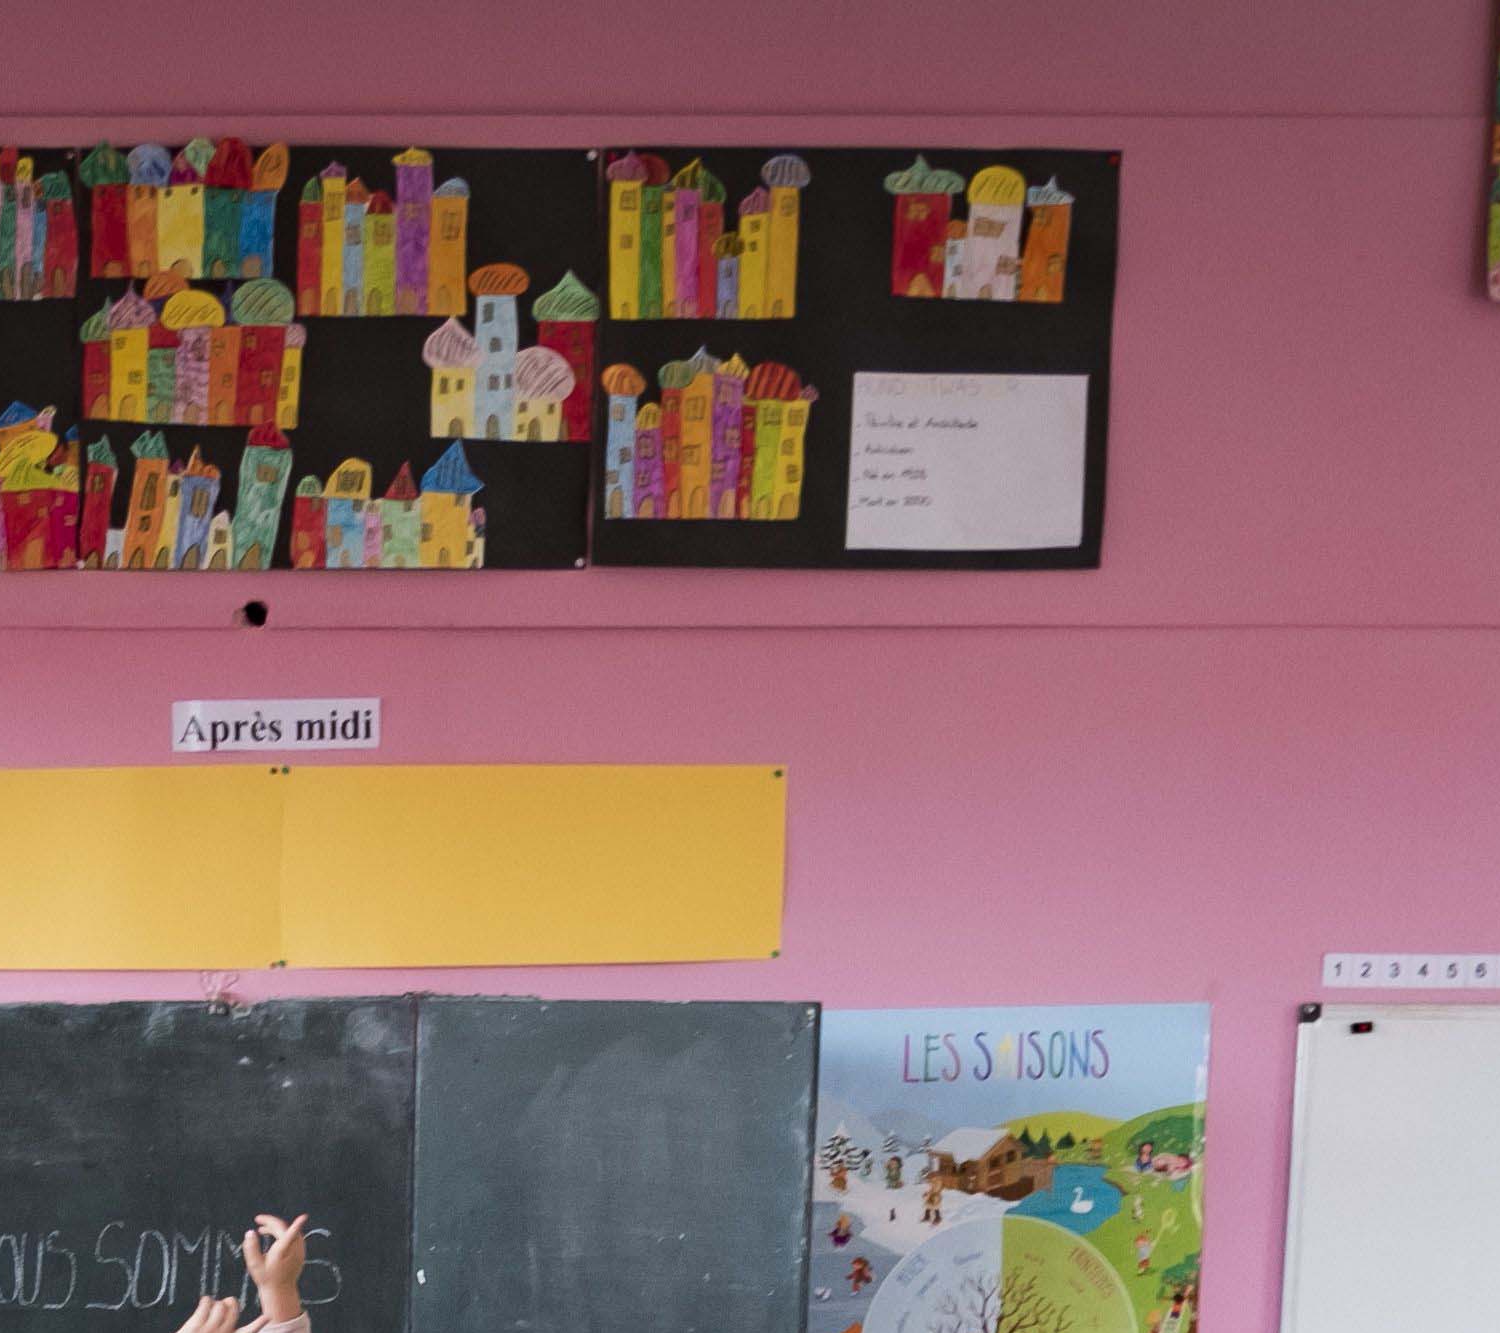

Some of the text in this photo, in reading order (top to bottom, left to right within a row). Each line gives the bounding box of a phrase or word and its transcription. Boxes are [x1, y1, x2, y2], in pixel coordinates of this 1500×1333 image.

[179, 709, 373, 750] Après midi
[1332, 962, 1343, 978] 1
[1360, 962, 1373, 978] 2
[1387, 962, 1401, 978] 3
[1416, 962, 1429, 978] 4
[1446, 962, 1459, 978] 5
[1474, 962, 1488, 978] 6
[903, 1032, 961, 1083] LES
[85, 1220, 342, 1311] SOMMS
